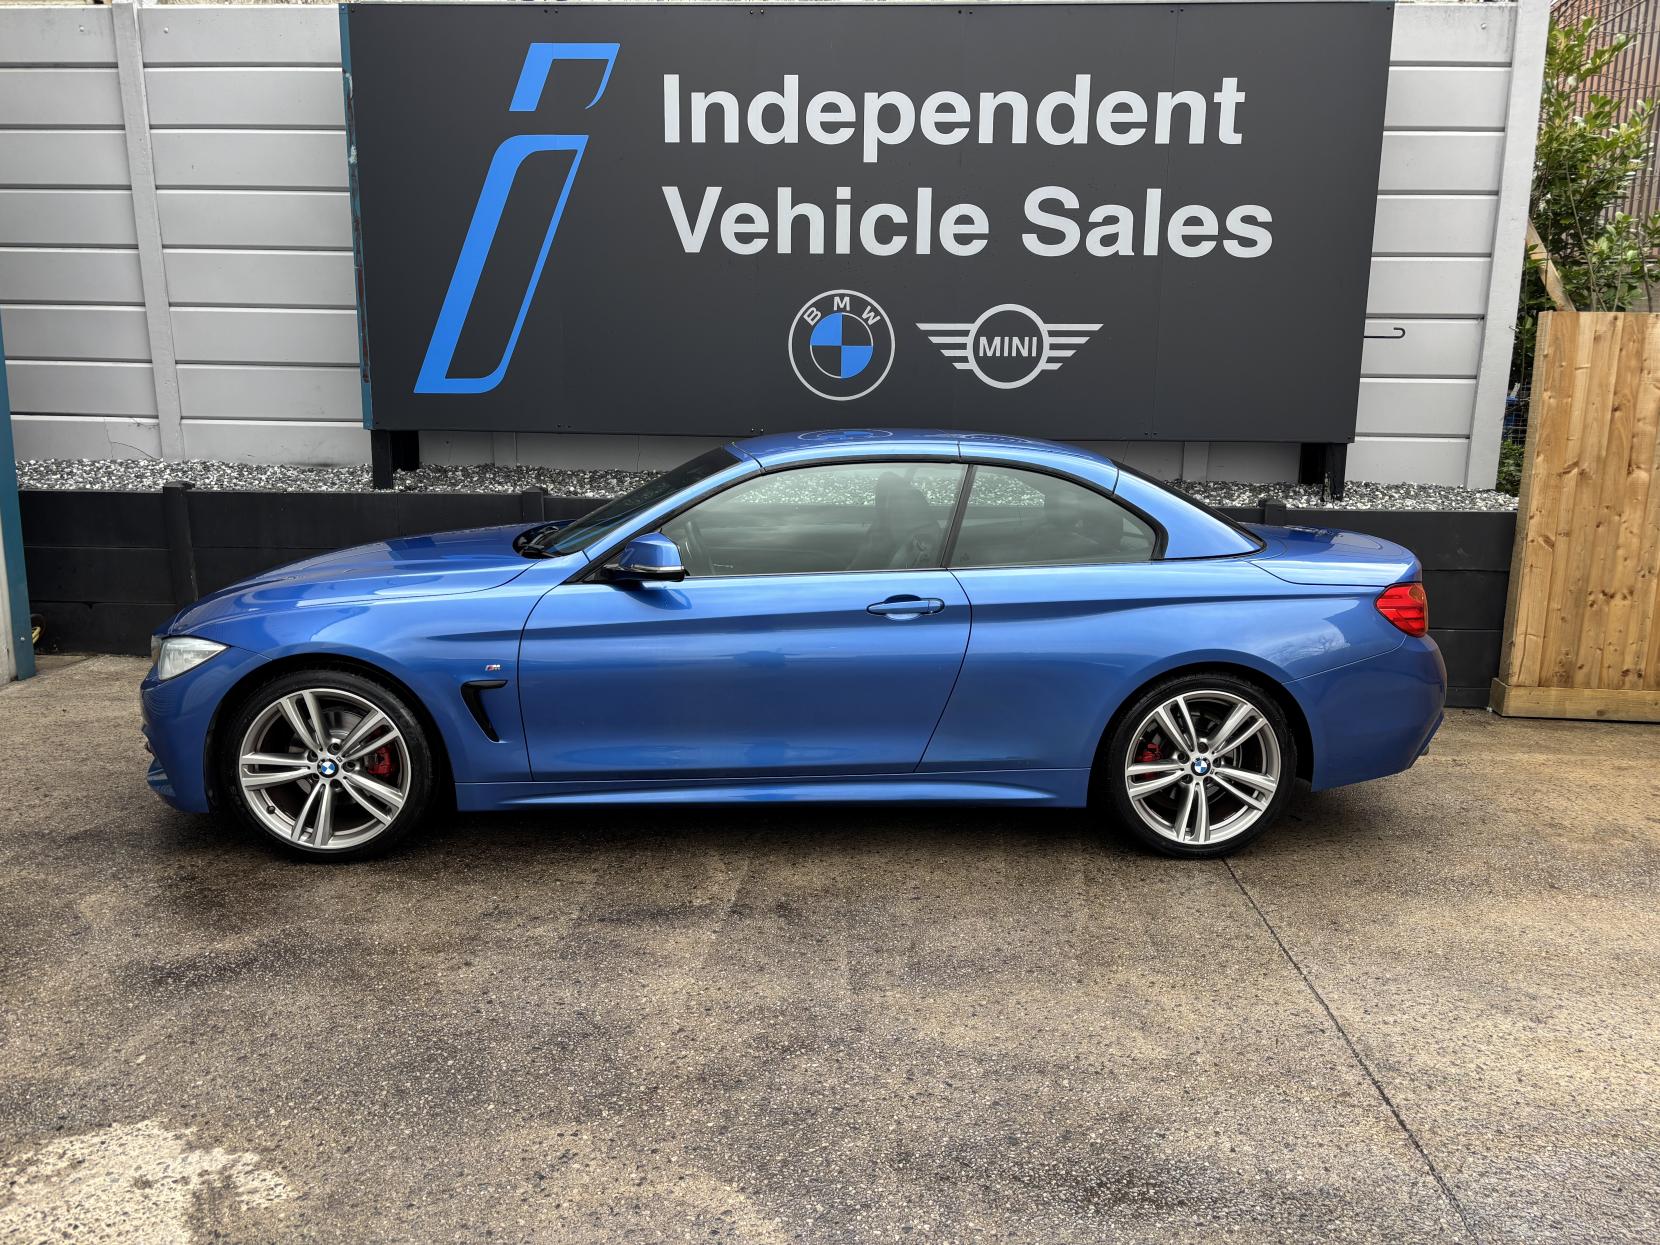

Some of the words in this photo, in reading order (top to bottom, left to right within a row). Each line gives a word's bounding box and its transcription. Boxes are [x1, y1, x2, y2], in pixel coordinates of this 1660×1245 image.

[663, 73, 1246, 163] Independent
[661, 186, 990, 257] Vehicle
[1021, 185, 1273, 259] Sales
[803, 296, 881, 326] BMW
[979, 336, 1038, 357] MINI
